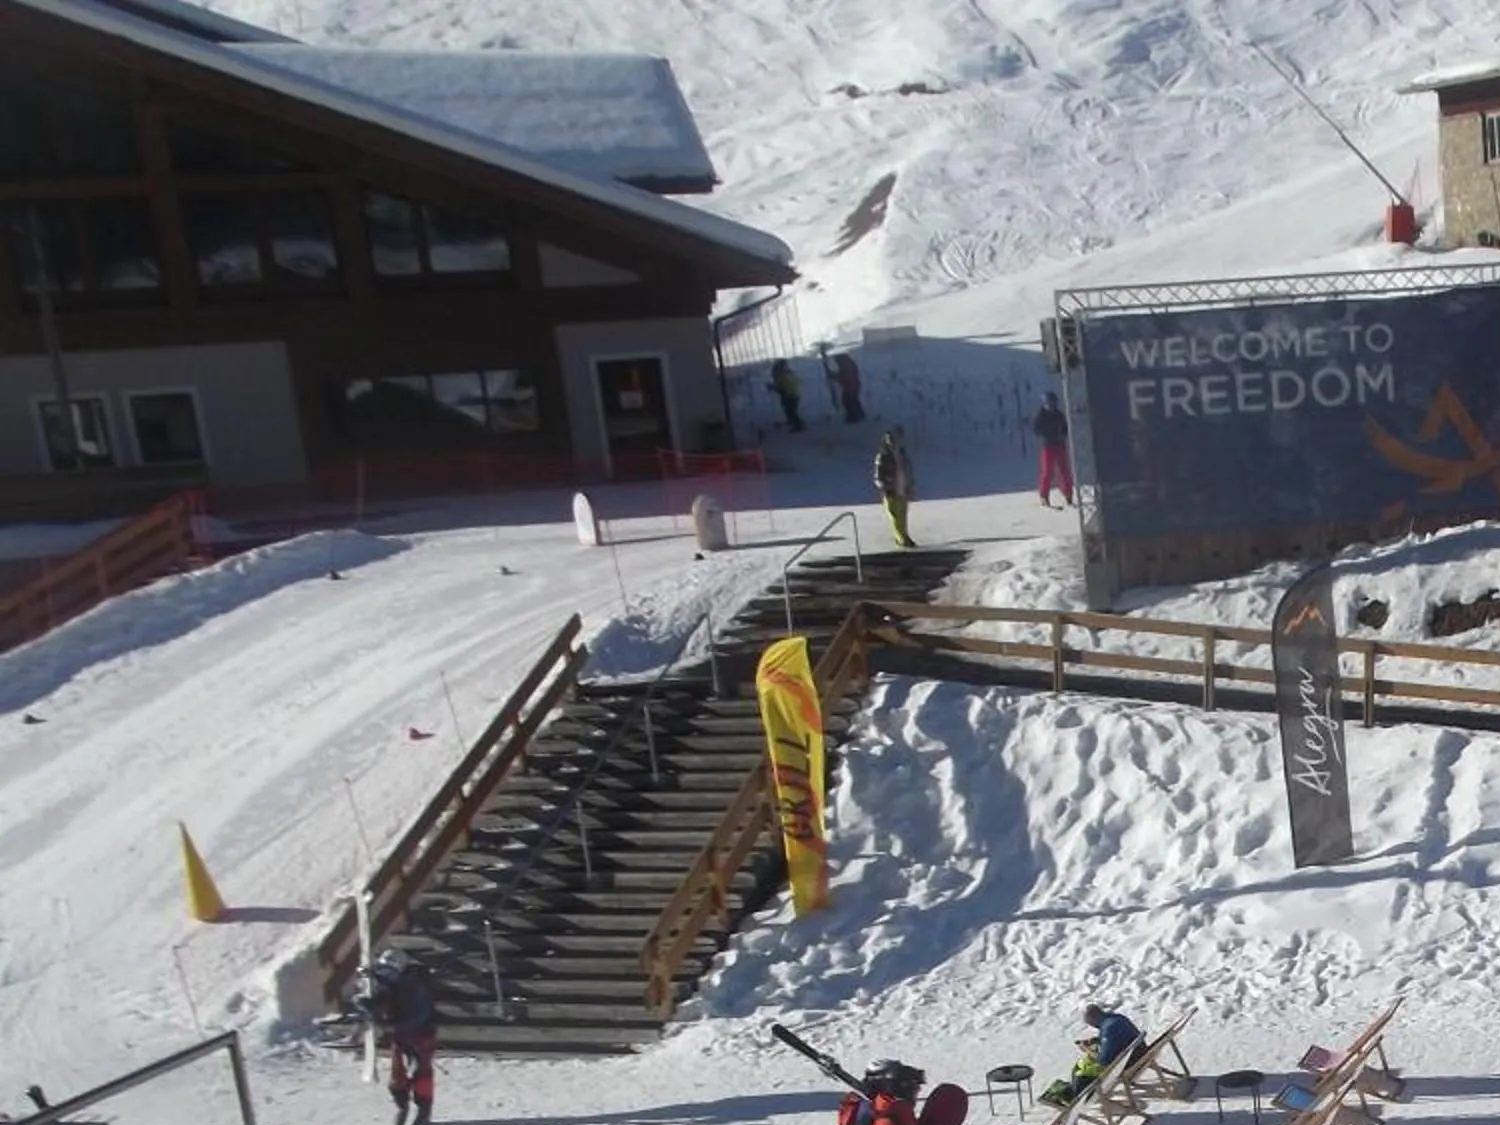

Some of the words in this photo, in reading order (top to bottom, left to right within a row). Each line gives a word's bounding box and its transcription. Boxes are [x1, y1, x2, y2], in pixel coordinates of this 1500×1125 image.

[1119, 326, 1329, 369] WELCOME
[1341, 323, 1394, 353] TO
[1127, 363, 1395, 420] FREEDOM
[1291, 666, 1340, 797] Alegra
